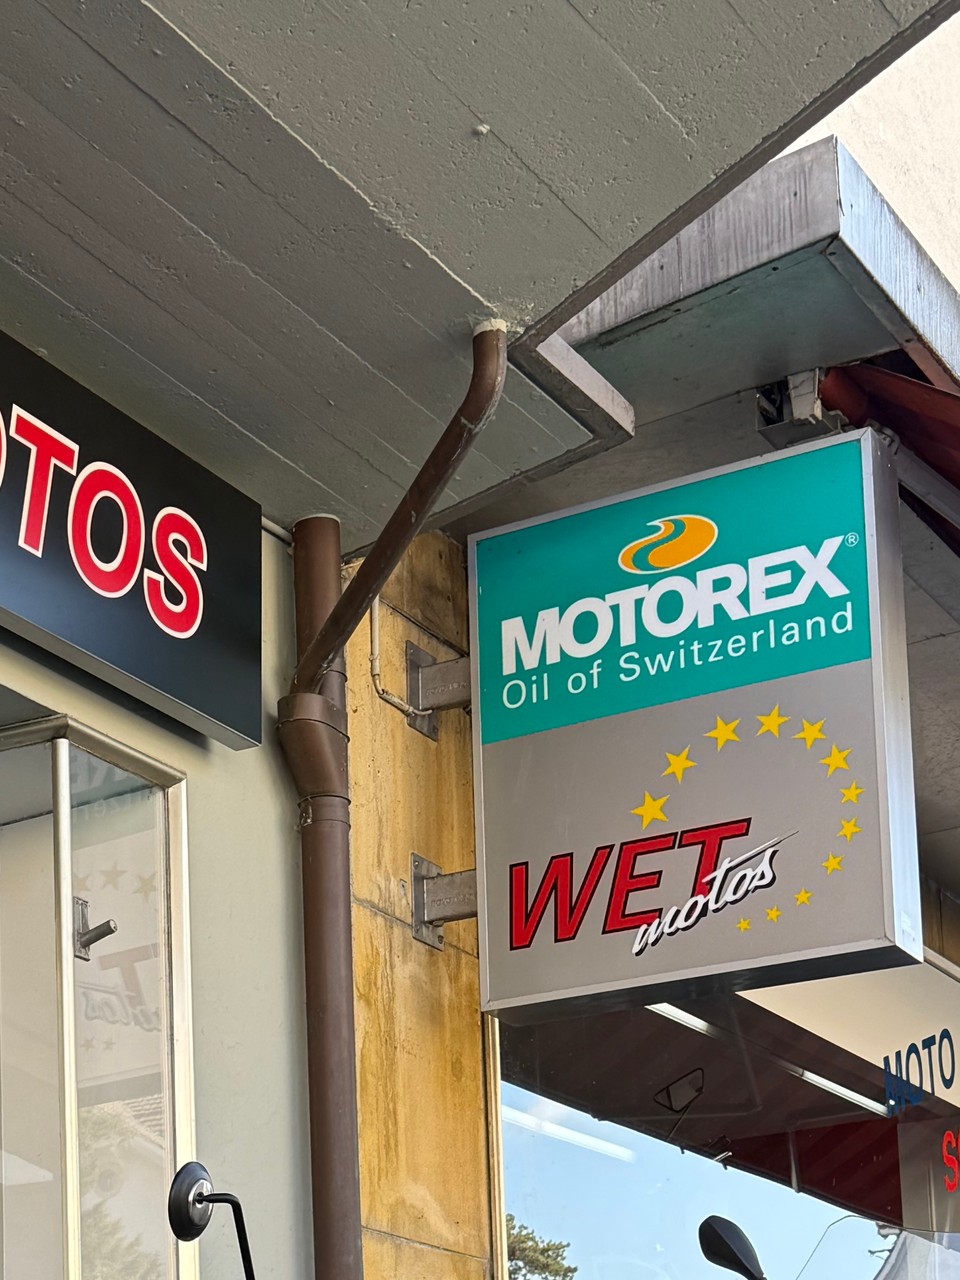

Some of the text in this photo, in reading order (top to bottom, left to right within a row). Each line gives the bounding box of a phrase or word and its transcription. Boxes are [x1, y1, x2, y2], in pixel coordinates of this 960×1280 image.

[501, 535, 850, 676] MOTOREX
[502, 673, 548, 709] Oil
[567, 659, 602, 694] of
[619, 601, 853, 682] Switzerland
[509, 817, 752, 951] WET
[631, 831, 799, 956] motos
[883, 1028, 956, 1119] MOTO
[941, 1126, 960, 1193] S
